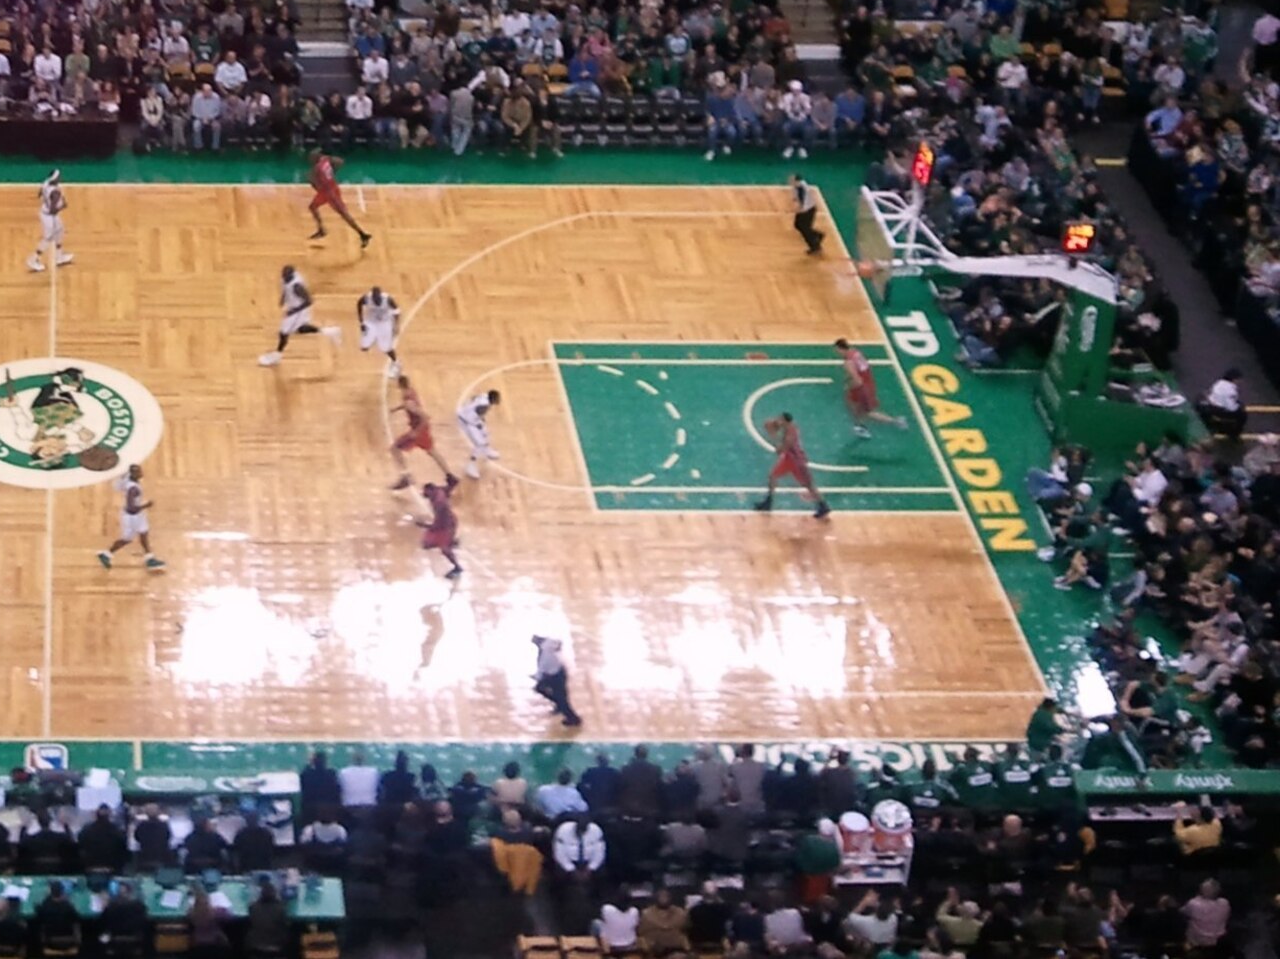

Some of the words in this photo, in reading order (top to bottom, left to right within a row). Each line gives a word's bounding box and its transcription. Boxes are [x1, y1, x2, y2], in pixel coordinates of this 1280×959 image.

[886, 310, 941, 357] TD
[94, 388, 132, 448] BOSTON
[911, 363, 1037, 552] GARDEN
[1094, 773, 1153, 789] xinity
